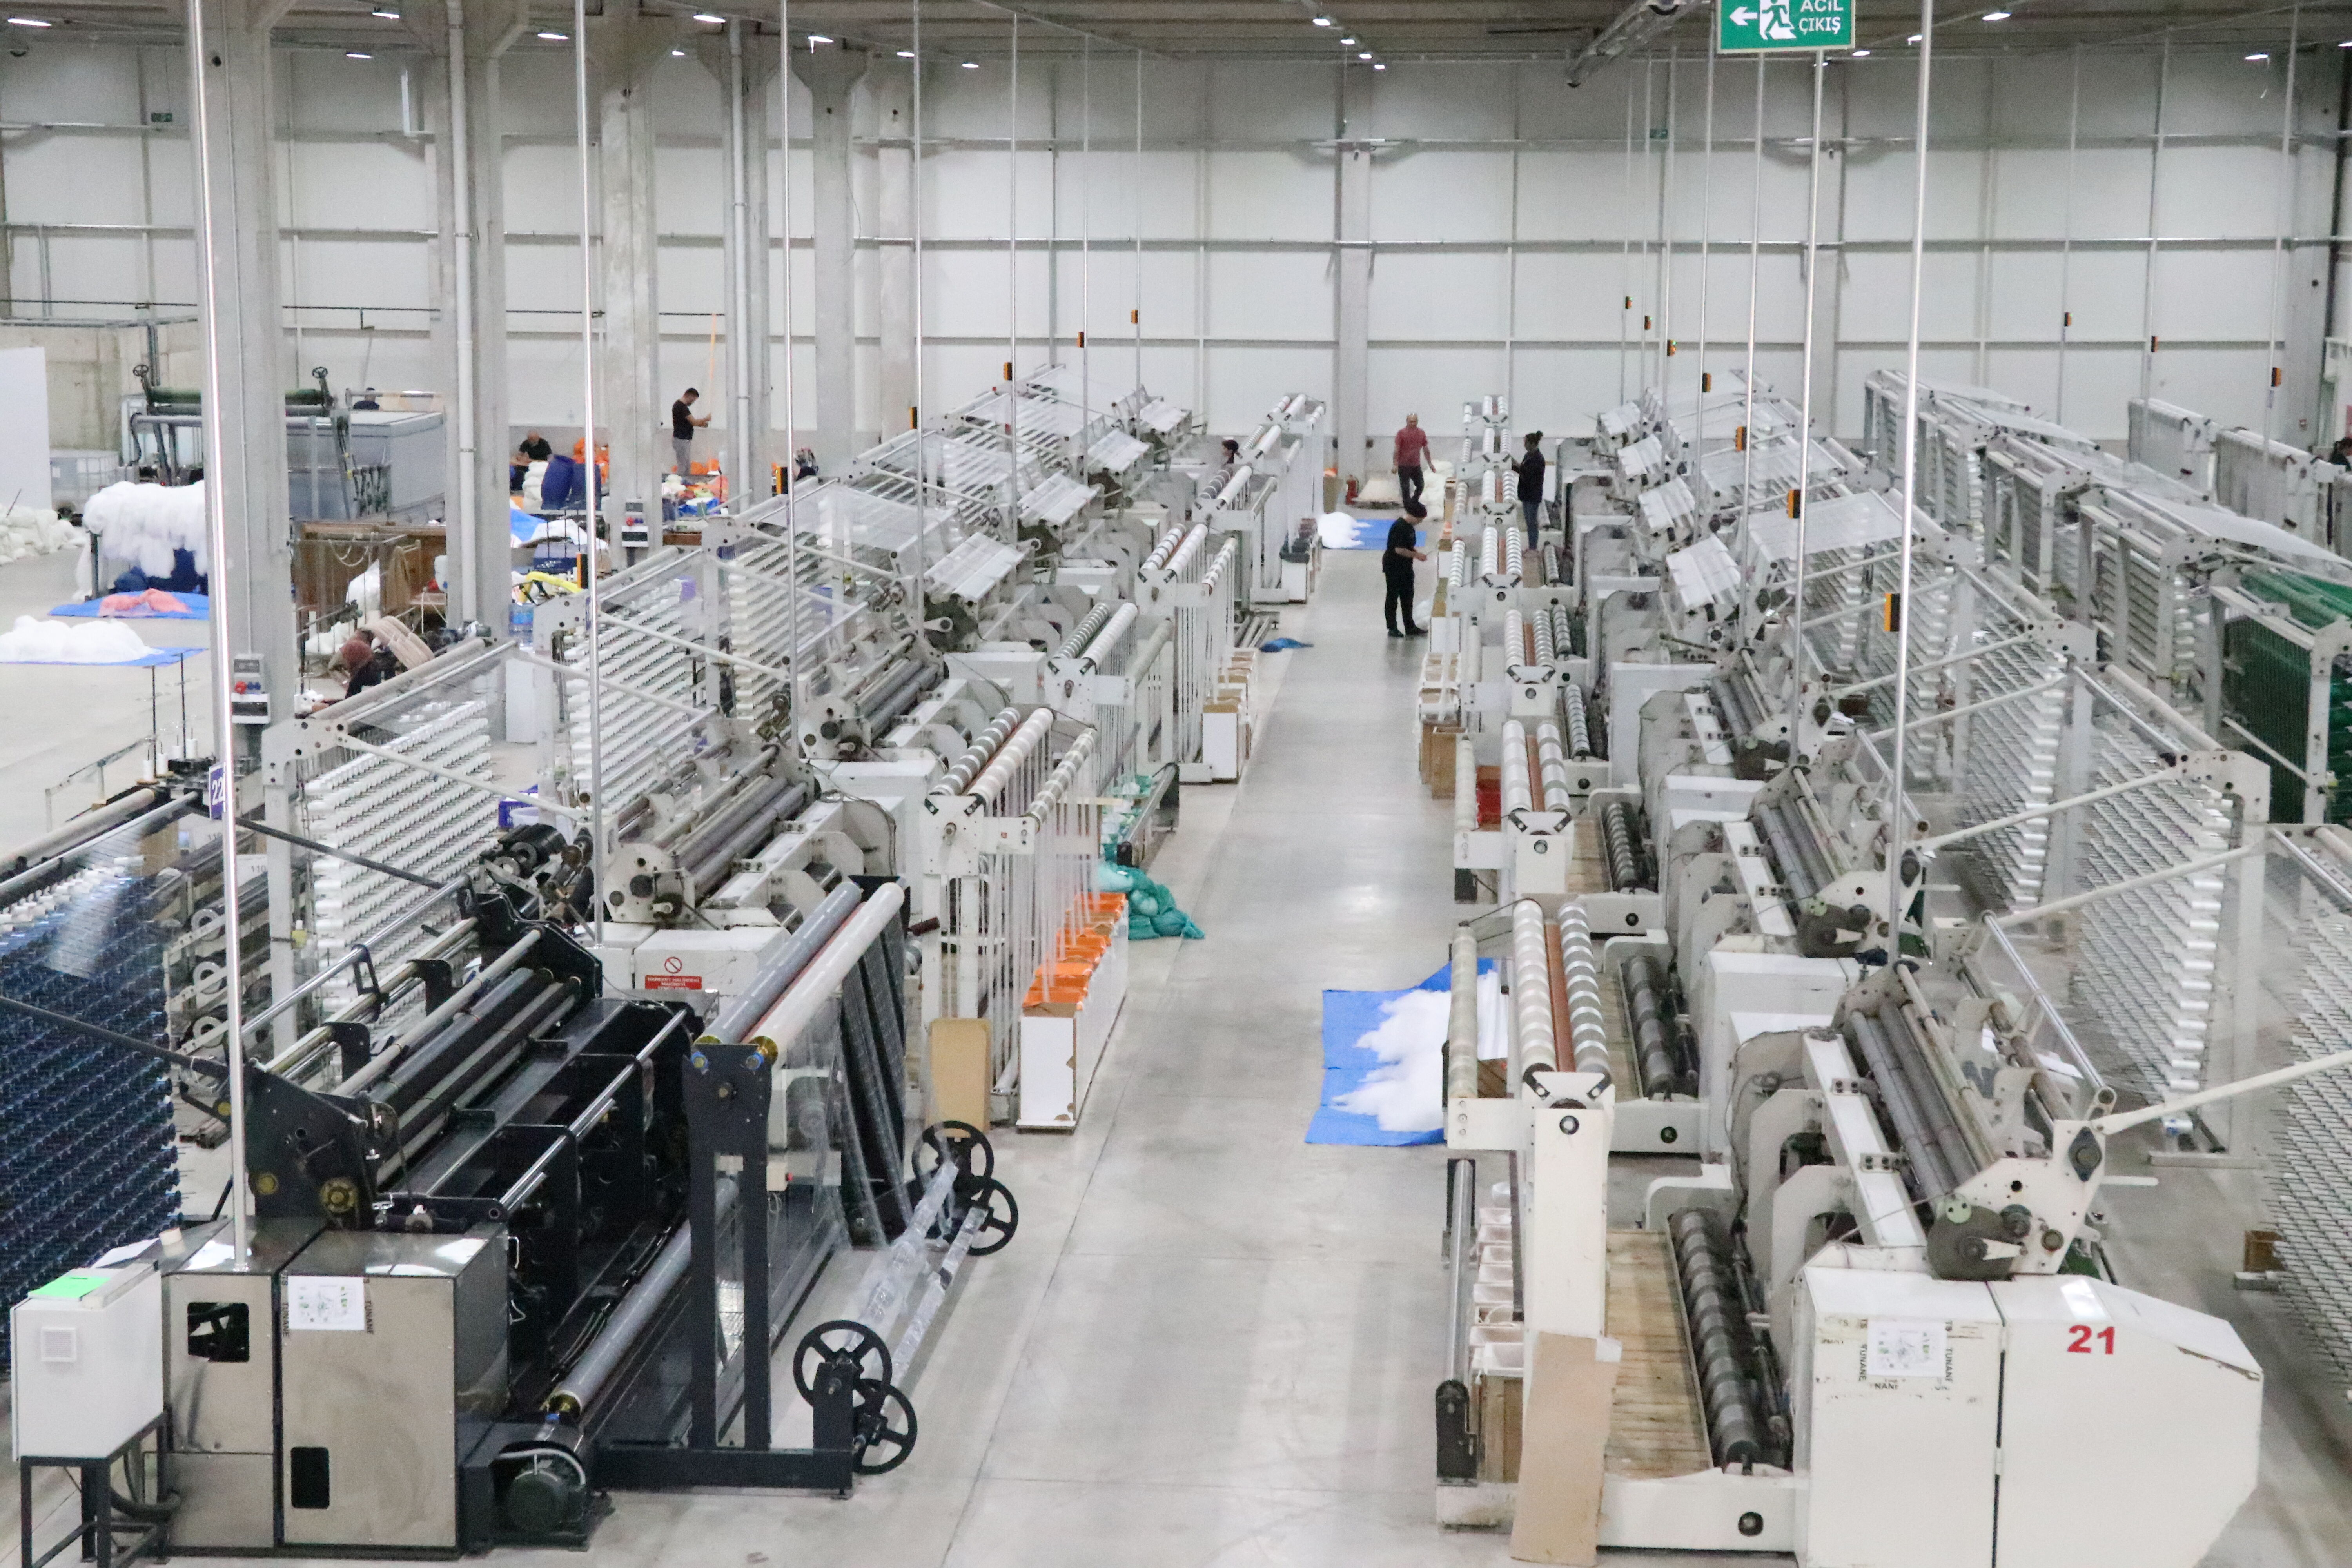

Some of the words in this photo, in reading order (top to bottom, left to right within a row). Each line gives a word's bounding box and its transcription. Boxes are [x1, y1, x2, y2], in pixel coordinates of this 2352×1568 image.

[1799, 16, 1841, 35] ÇIKIŞ
[212, 777, 224, 805] 22
[2067, 1325, 2114, 1355] 21
